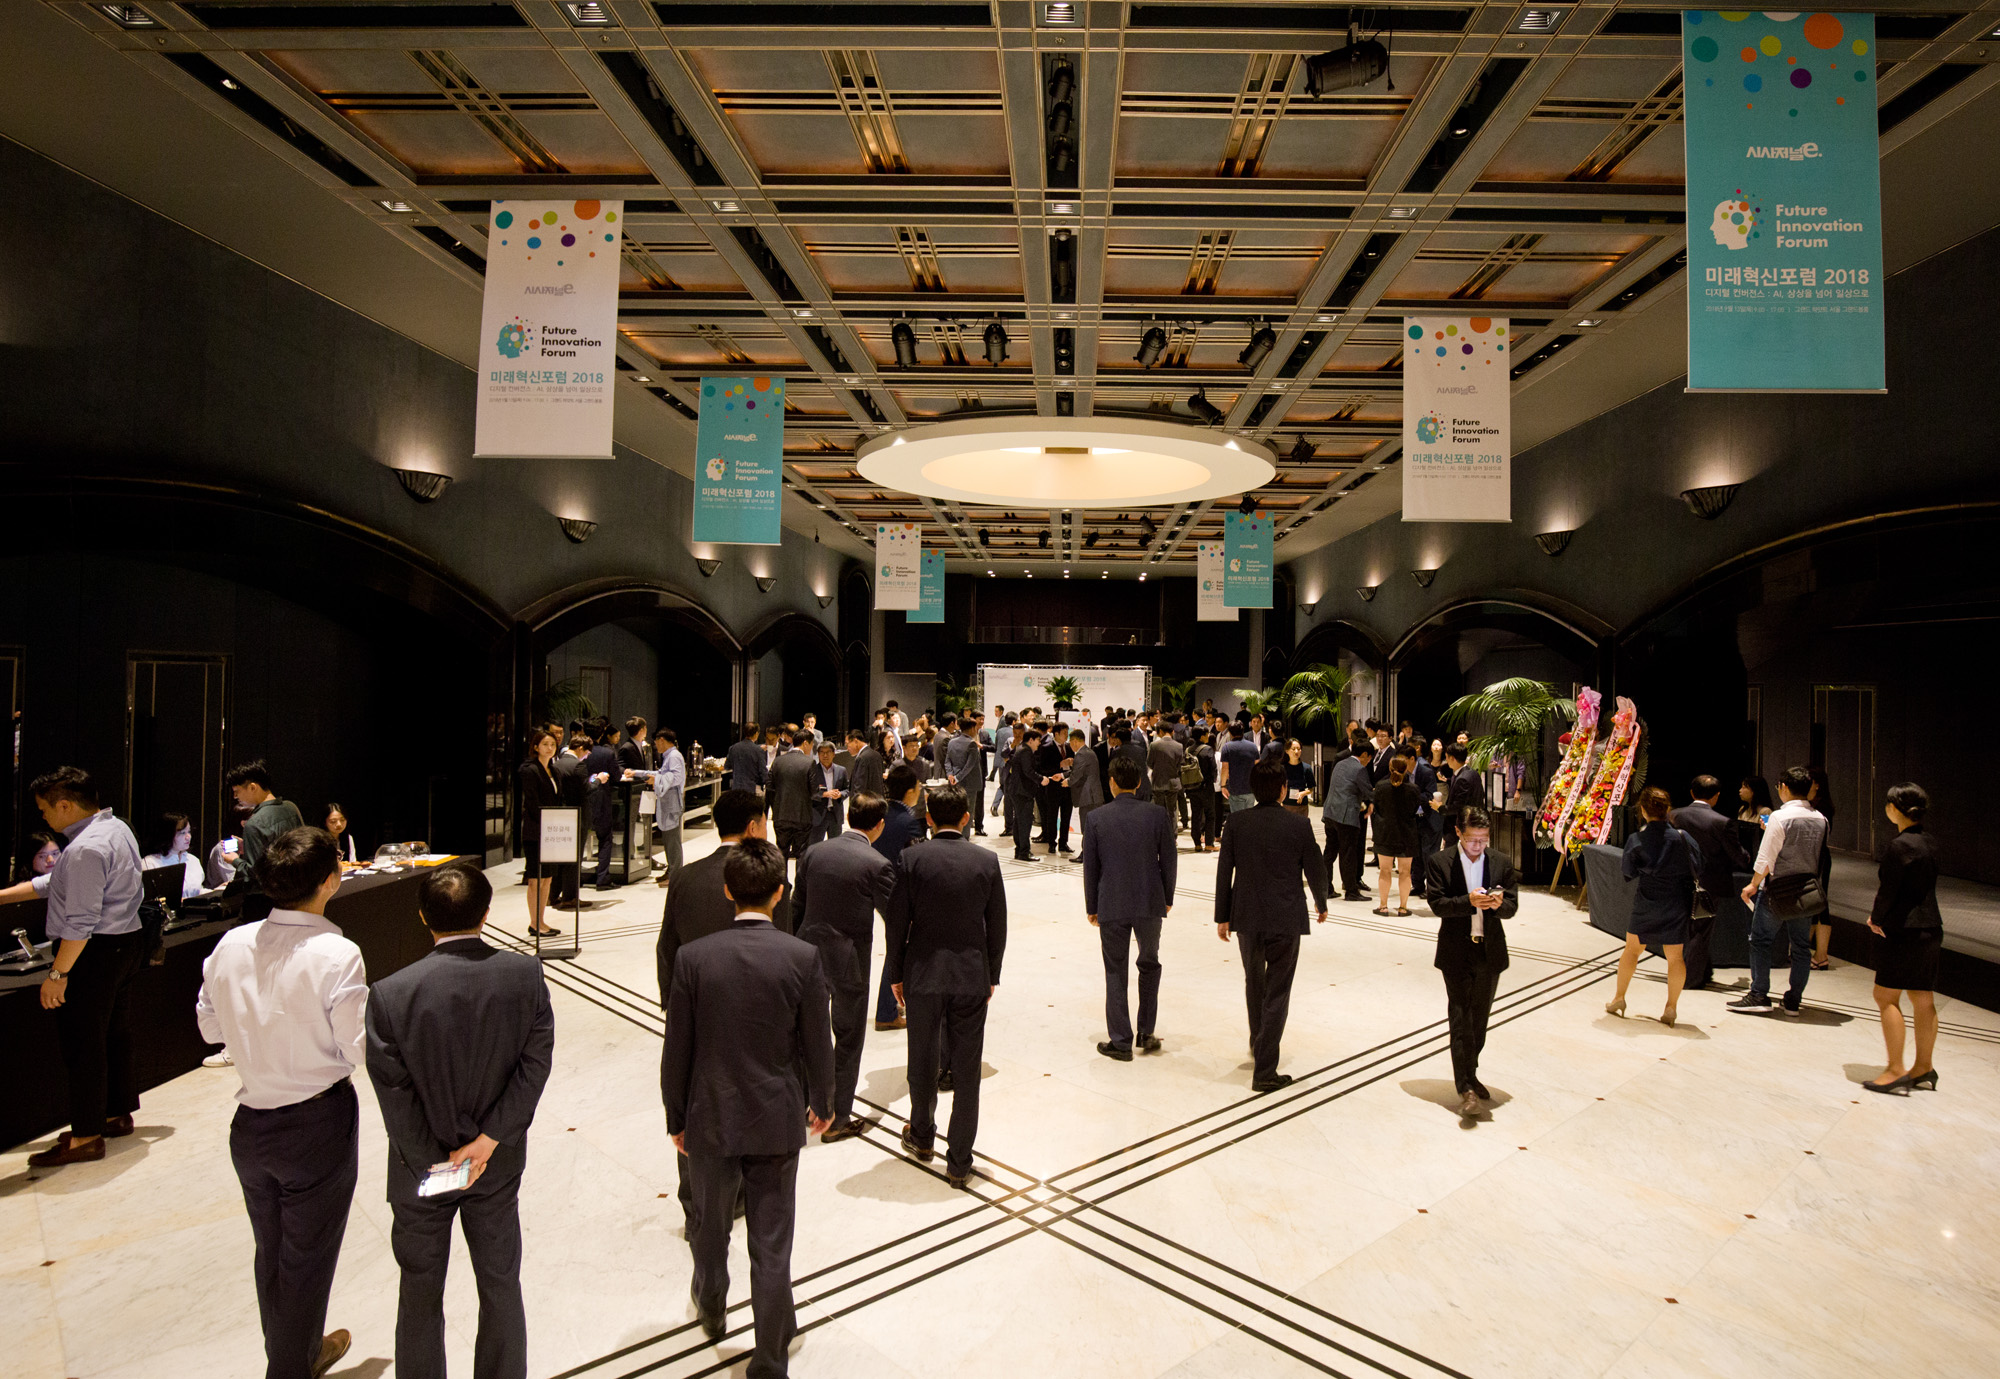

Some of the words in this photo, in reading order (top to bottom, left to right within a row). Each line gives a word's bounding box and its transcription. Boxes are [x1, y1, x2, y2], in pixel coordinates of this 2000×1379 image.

[1776, 204, 1828, 216] Future
[1776, 218, 1863, 232] Innovation
[1776, 236, 1828, 248] Forum
[1706, 266, 1816, 286] 미래혁신포럼
[1824, 268, 1870, 284] 2018
[1705, 288, 1730, 298] 디지털
[1734, 288, 1765, 298] 컨버전스
[1787, 289, 1812, 298] 상상을
[1816, 289, 1832, 298] 넘어
[1836, 289, 1869, 298] 일상으로
[542, 326, 577, 335] Future
[542, 337, 601, 346] Innovation
[541, 348, 576, 357] Forum
[490, 370, 567, 384] 미래혁신포럼
[572, 372, 604, 384] 2018
[1412, 453, 1474, 464] 미래혁신포럼
[1478, 455, 1502, 464] 2018
[702, 488, 752, 498] 미래혁신포럼
